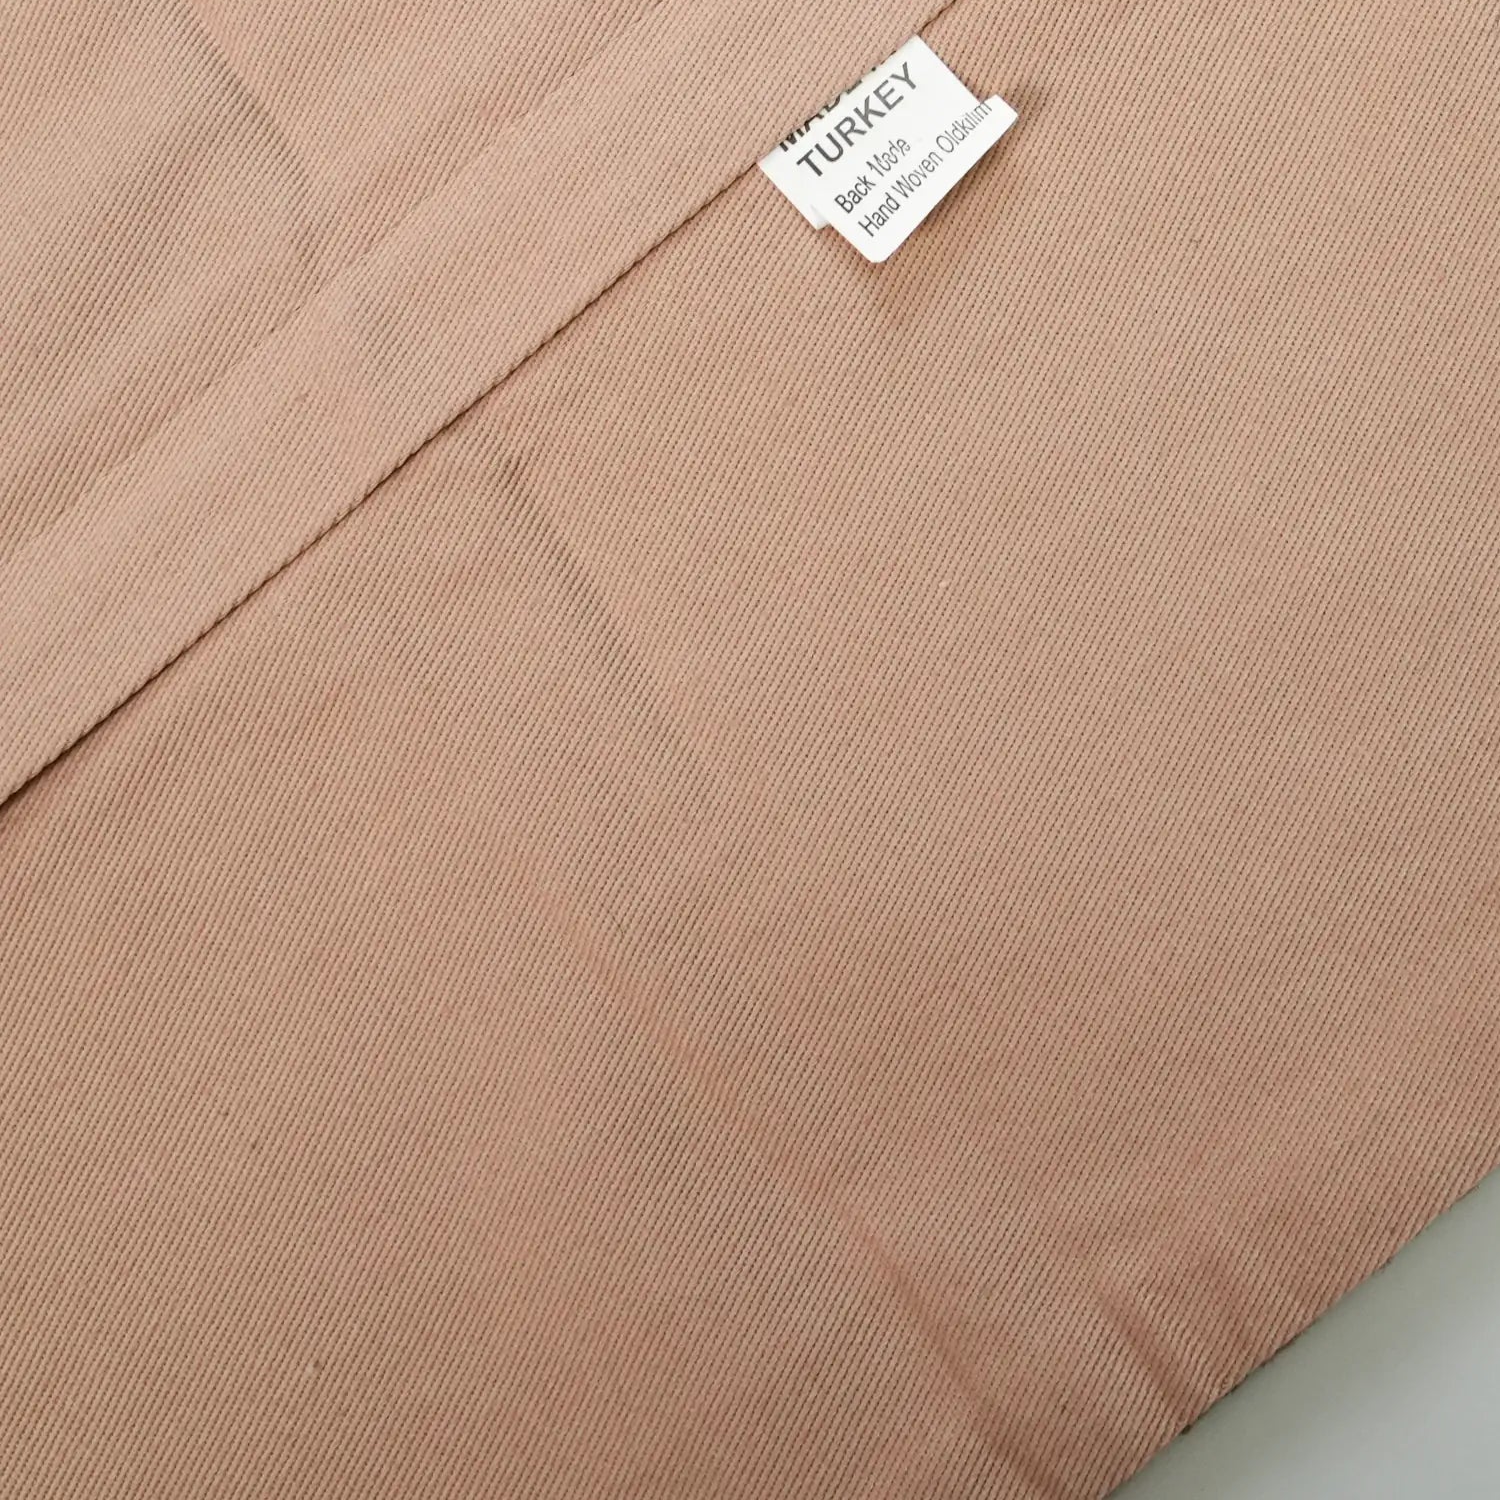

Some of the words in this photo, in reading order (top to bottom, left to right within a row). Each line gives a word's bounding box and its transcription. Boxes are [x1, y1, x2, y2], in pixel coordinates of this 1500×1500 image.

[796, 61, 917, 177] TURKEY
[834, 175, 877, 214] Back
[858, 191, 901, 238] Hand
[891, 149, 944, 199] Woven
